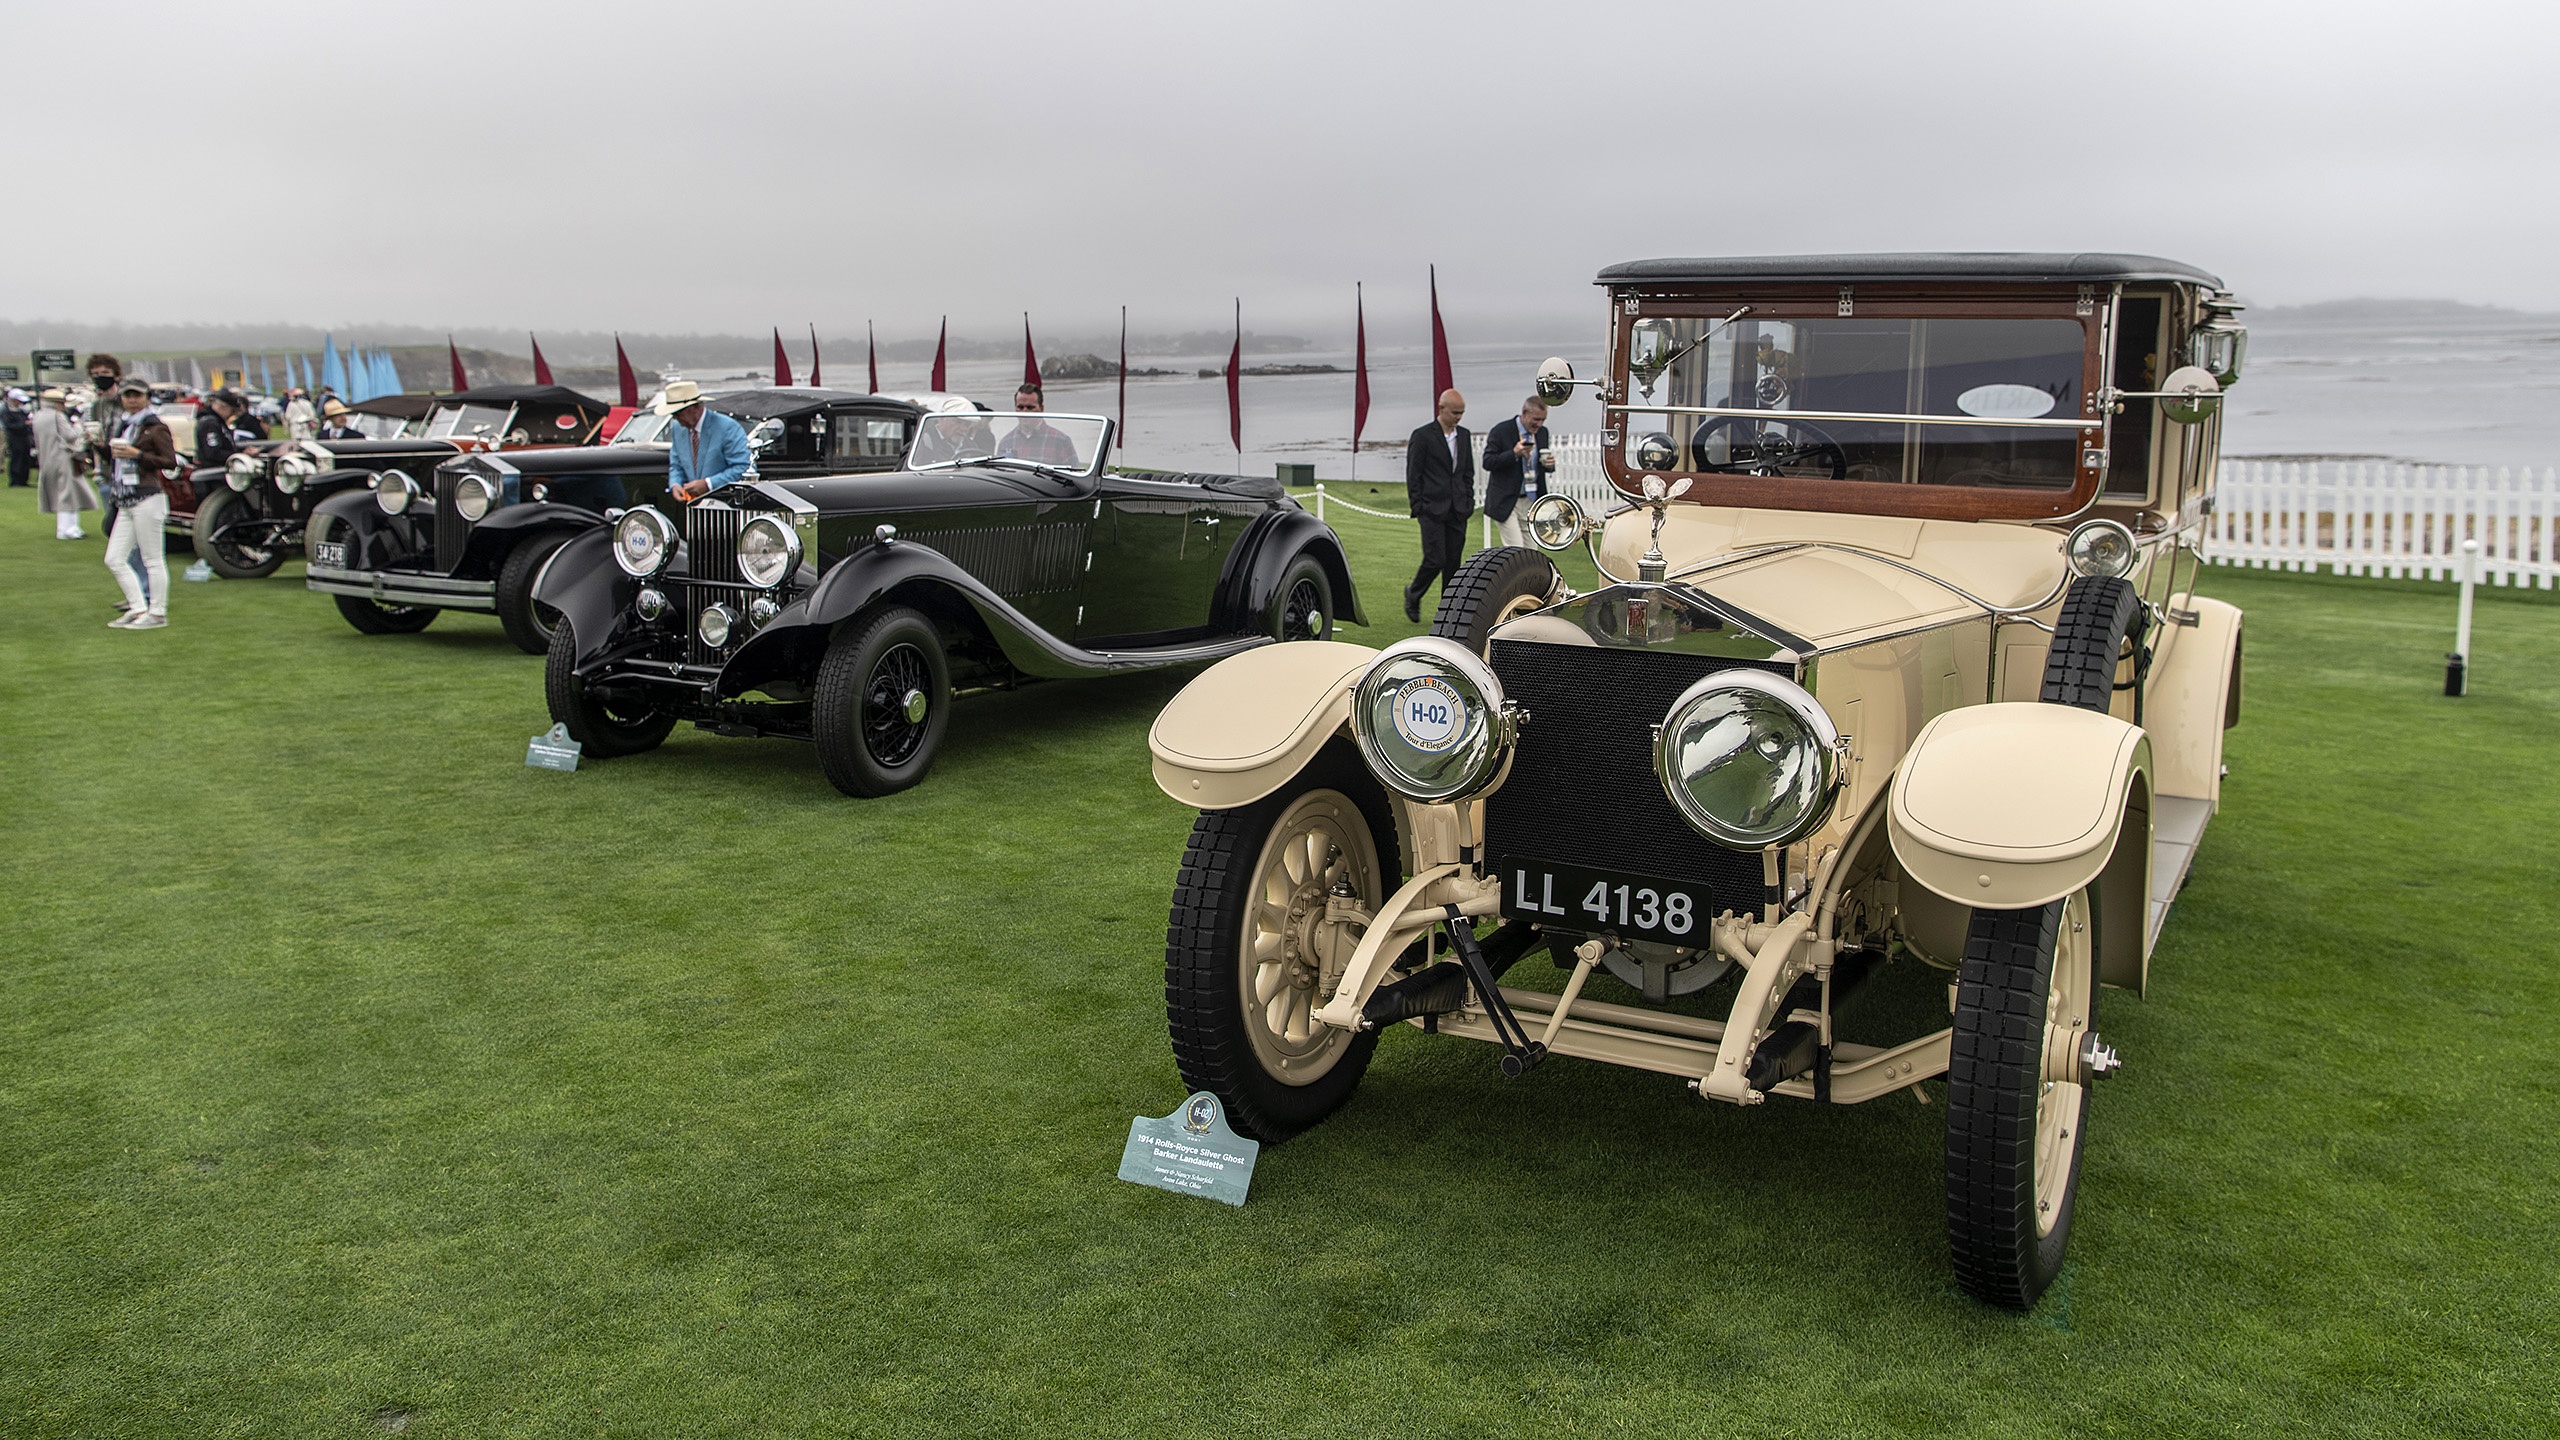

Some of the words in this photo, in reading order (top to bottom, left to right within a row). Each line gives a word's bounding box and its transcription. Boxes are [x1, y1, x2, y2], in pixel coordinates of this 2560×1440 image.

[632, 537, 646, 546] H-06
[1399, 678, 1430, 700] PEBBLE
[1431, 678, 1459, 705] BEACH
[1412, 702, 1447, 724] H-02
[1405, 732, 1419, 747] Tour
[1516, 869, 1565, 916] LL
[1581, 881, 1693, 935] 4138
[1194, 1107, 1209, 1119] H-02
[1137, 1134, 1154, 1145] 1914
[1154, 1138, 1199, 1155] Rolls-Royce
[1200, 1148, 1221, 1160] Silver
[1222, 1153, 1245, 1165] Ghost
[1153, 1148, 1178, 1159] Barker
[1179, 1154, 1224, 1171] Landaulette
